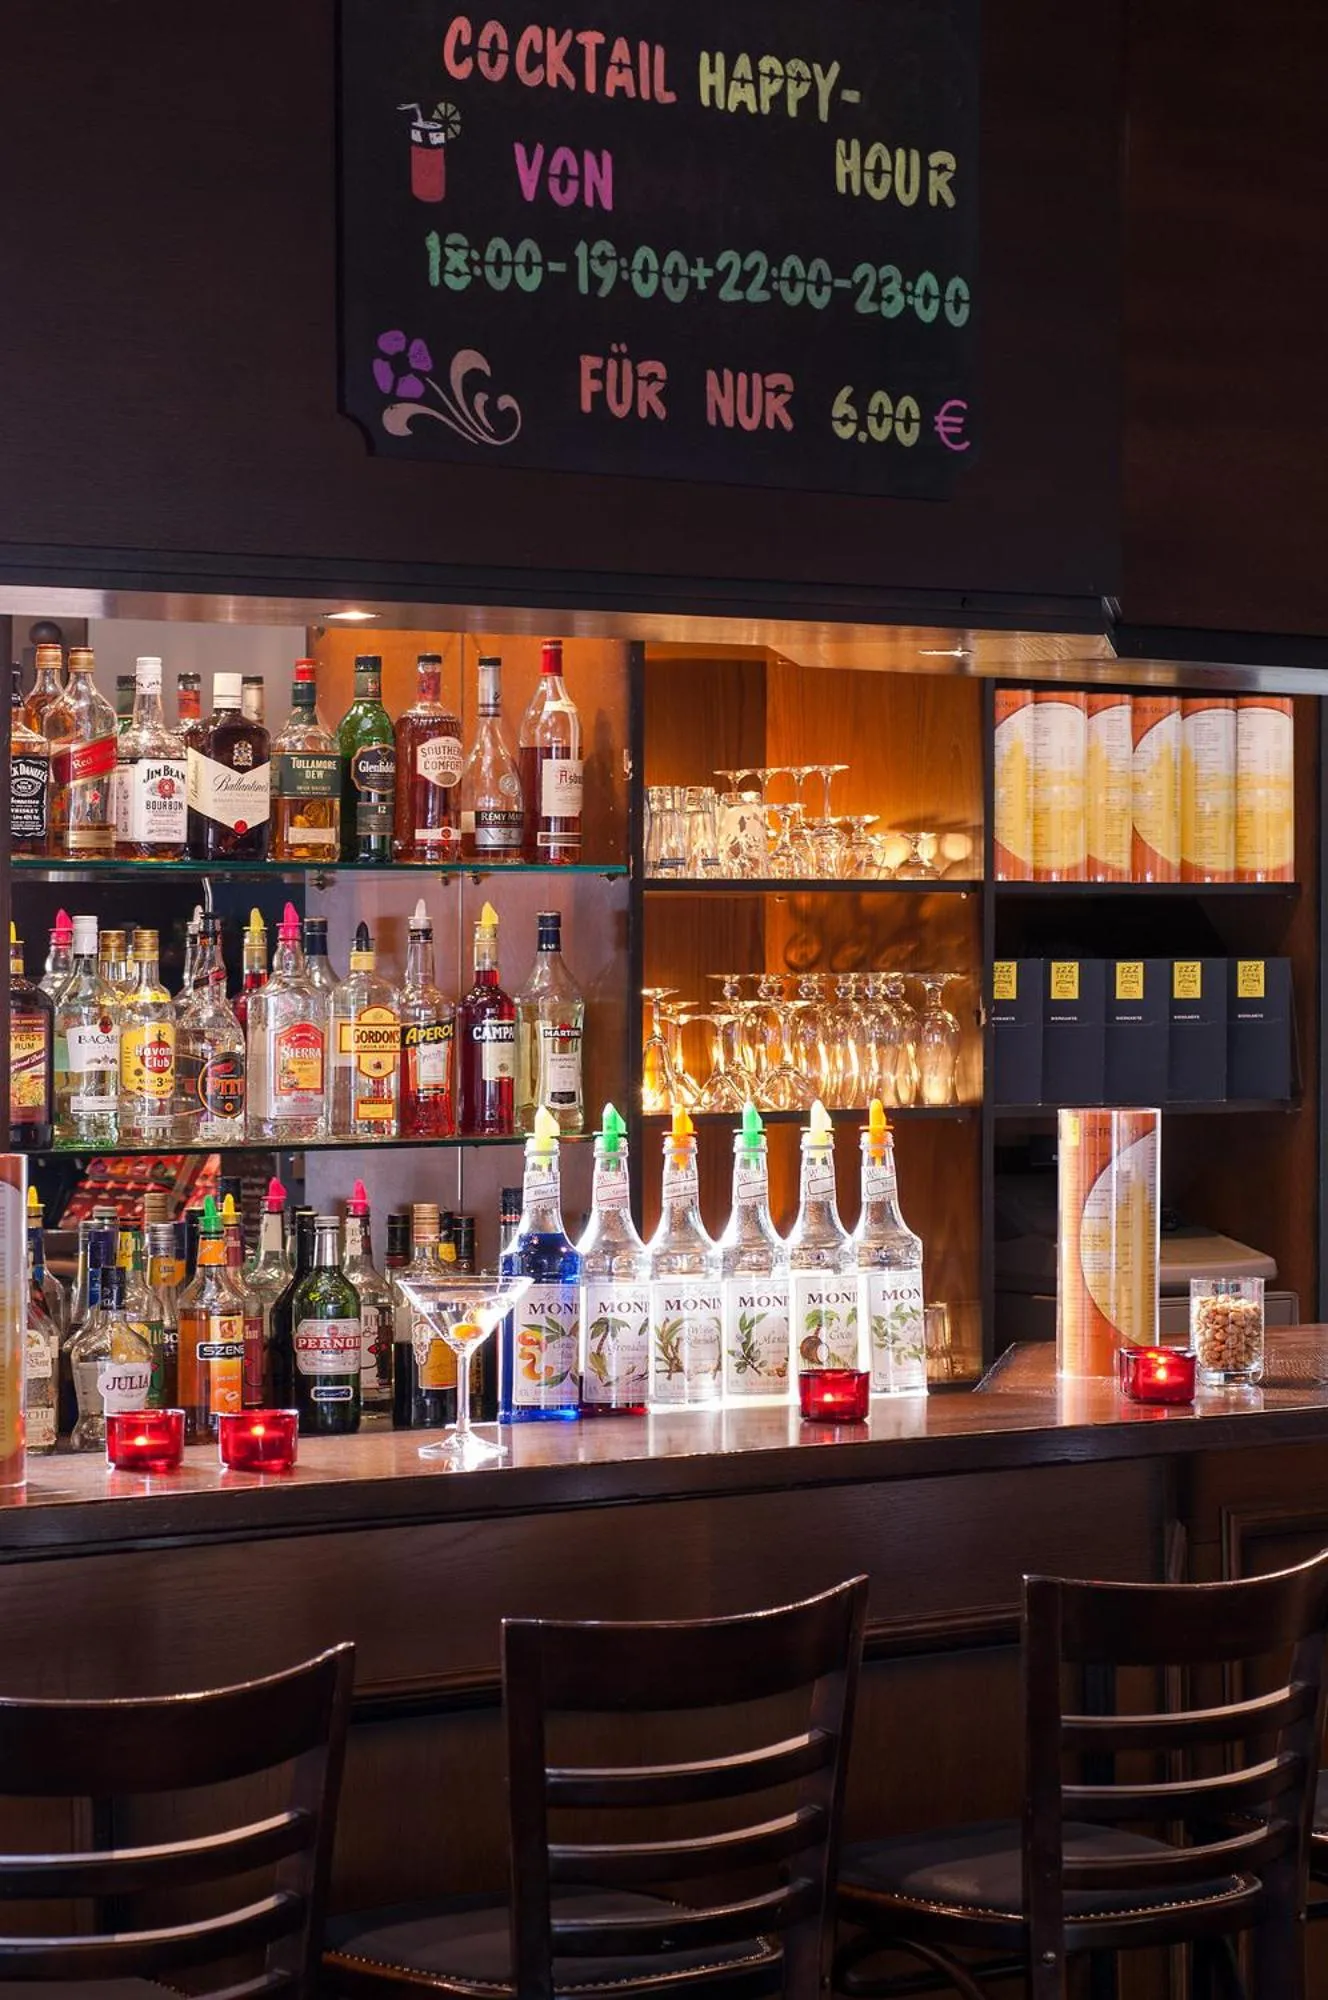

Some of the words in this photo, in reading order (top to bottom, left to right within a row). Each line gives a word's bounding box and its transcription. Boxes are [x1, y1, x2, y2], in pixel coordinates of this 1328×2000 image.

[444, 15, 677, 103] COCKTAIL
[700, 51, 861, 122] HAPPY-
[514, 142, 614, 211] VON
[835, 138, 957, 208] HOUR
[579, 343, 667, 421] FÜR
[706, 368, 795, 432] NUR
[831, 385, 921, 447] 6.00
[934, 400, 971, 451] €
[291, 756, 337, 770] TULLAMORE
[143, 768, 162, 783] JIM
[304, 769, 325, 780] DEW
[145, 800, 184, 811] BOURBON
[377, 805, 387, 814] 12
[14, 1042, 35, 1050] RUM
[283, 1046, 322, 1058] SIERRA
[145, 1057, 169, 1068] Club
